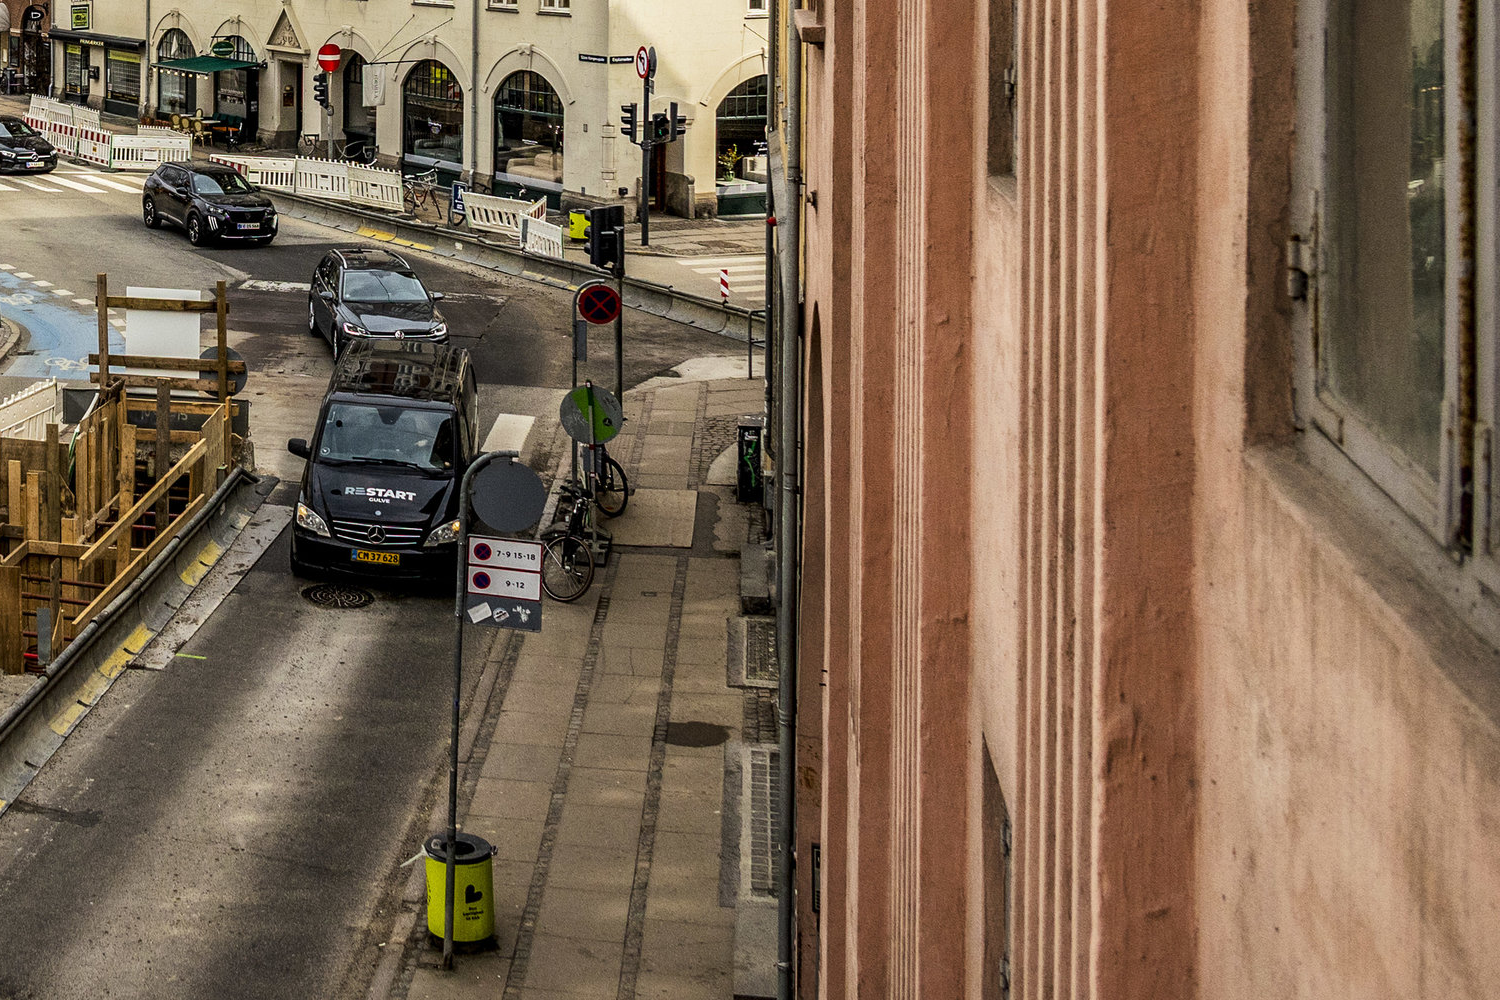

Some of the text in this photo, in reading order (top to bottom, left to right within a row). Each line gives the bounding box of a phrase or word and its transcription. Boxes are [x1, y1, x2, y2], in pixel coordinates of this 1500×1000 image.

[344, 486, 417, 501] RESTART
[371, 552, 381, 561] 37
[382, 554, 398, 564] 628
[513, 552, 536, 561] 15-18
